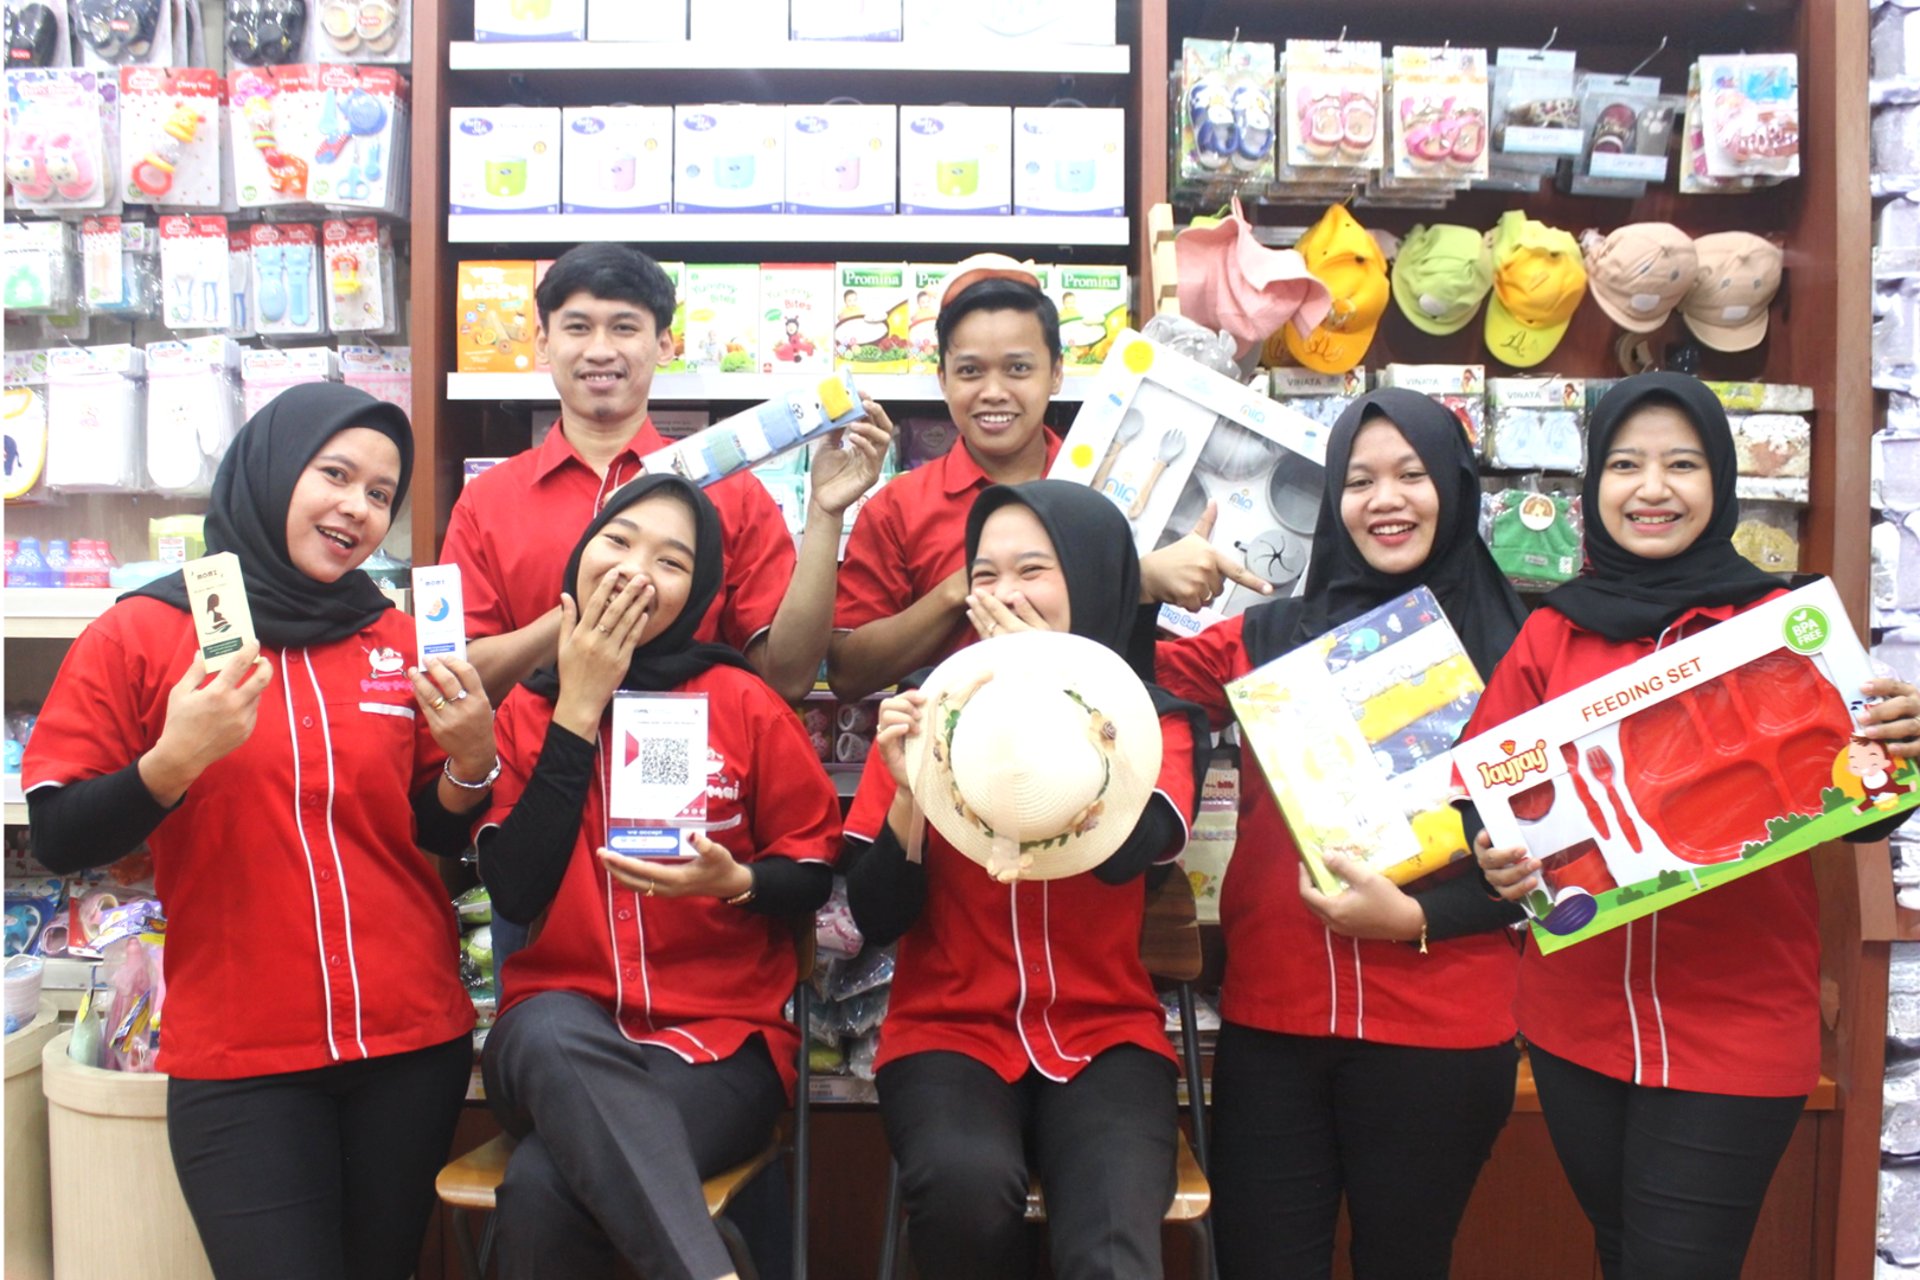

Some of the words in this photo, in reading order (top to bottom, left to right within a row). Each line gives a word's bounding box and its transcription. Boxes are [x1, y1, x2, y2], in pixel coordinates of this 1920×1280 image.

[845, 271, 900, 286] Promina
[1064, 273, 1119, 288] Promina
[1180, 614, 1201, 633] Set
[1791, 618, 1819, 637] BPA
[1796, 628, 1824, 646] FREE
[1581, 675, 1664, 722] FEEDING
[1666, 656, 1702, 684] SET
